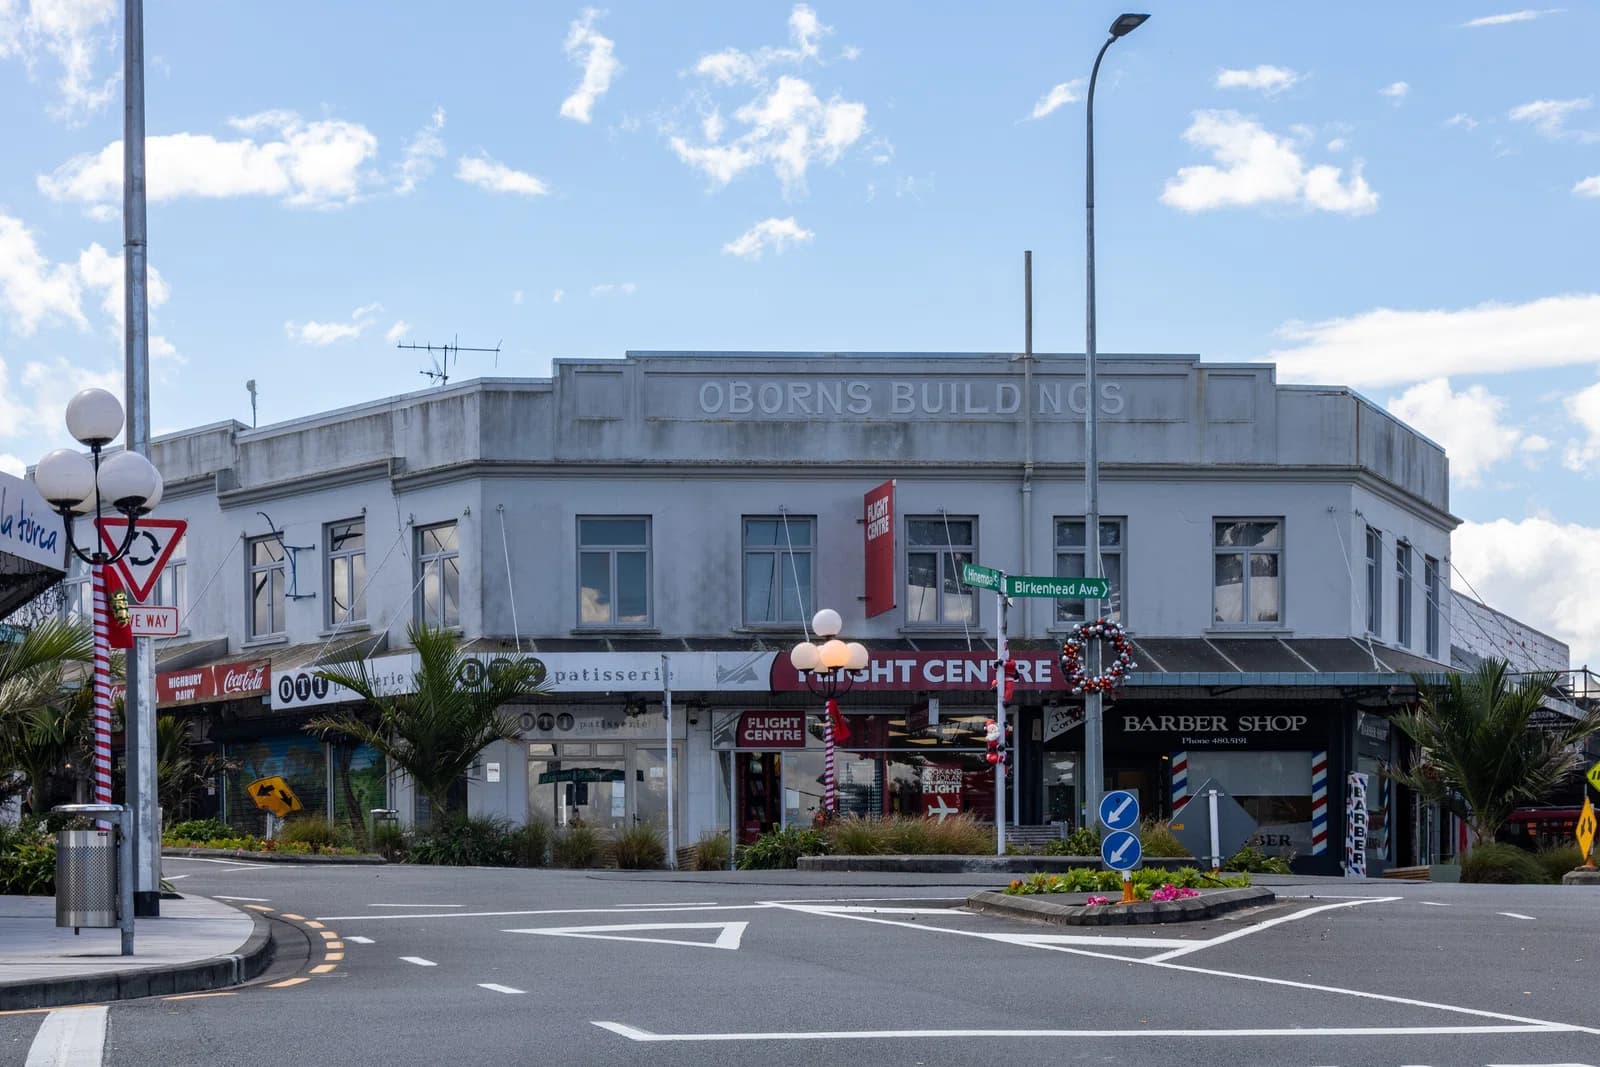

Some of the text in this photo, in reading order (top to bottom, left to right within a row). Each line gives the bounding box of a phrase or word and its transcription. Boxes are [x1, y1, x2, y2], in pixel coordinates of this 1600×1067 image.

[700, 381, 1125, 415] OBORNS BUILDNGS
[0, 487, 14, 539] la
[867, 496, 889, 524] FLIGHT
[867, 515, 889, 541] CENTRE
[1014, 580, 1099, 596] Birkenhead Ave
[146, 613, 169, 628] WAY
[922, 659, 1052, 683] CENRE
[168, 673, 202, 689] HIGHBURY
[175, 688, 196, 701] DAIRY
[747, 716, 801, 729] FLIGHT
[1121, 715, 1308, 732] BARBER SHOP
[744, 729, 802, 741] CENTRE
[1181, 736, 1210, 745] Phone
[922, 784, 962, 793] FLIGHT
[1353, 786, 1366, 865] BARBER
